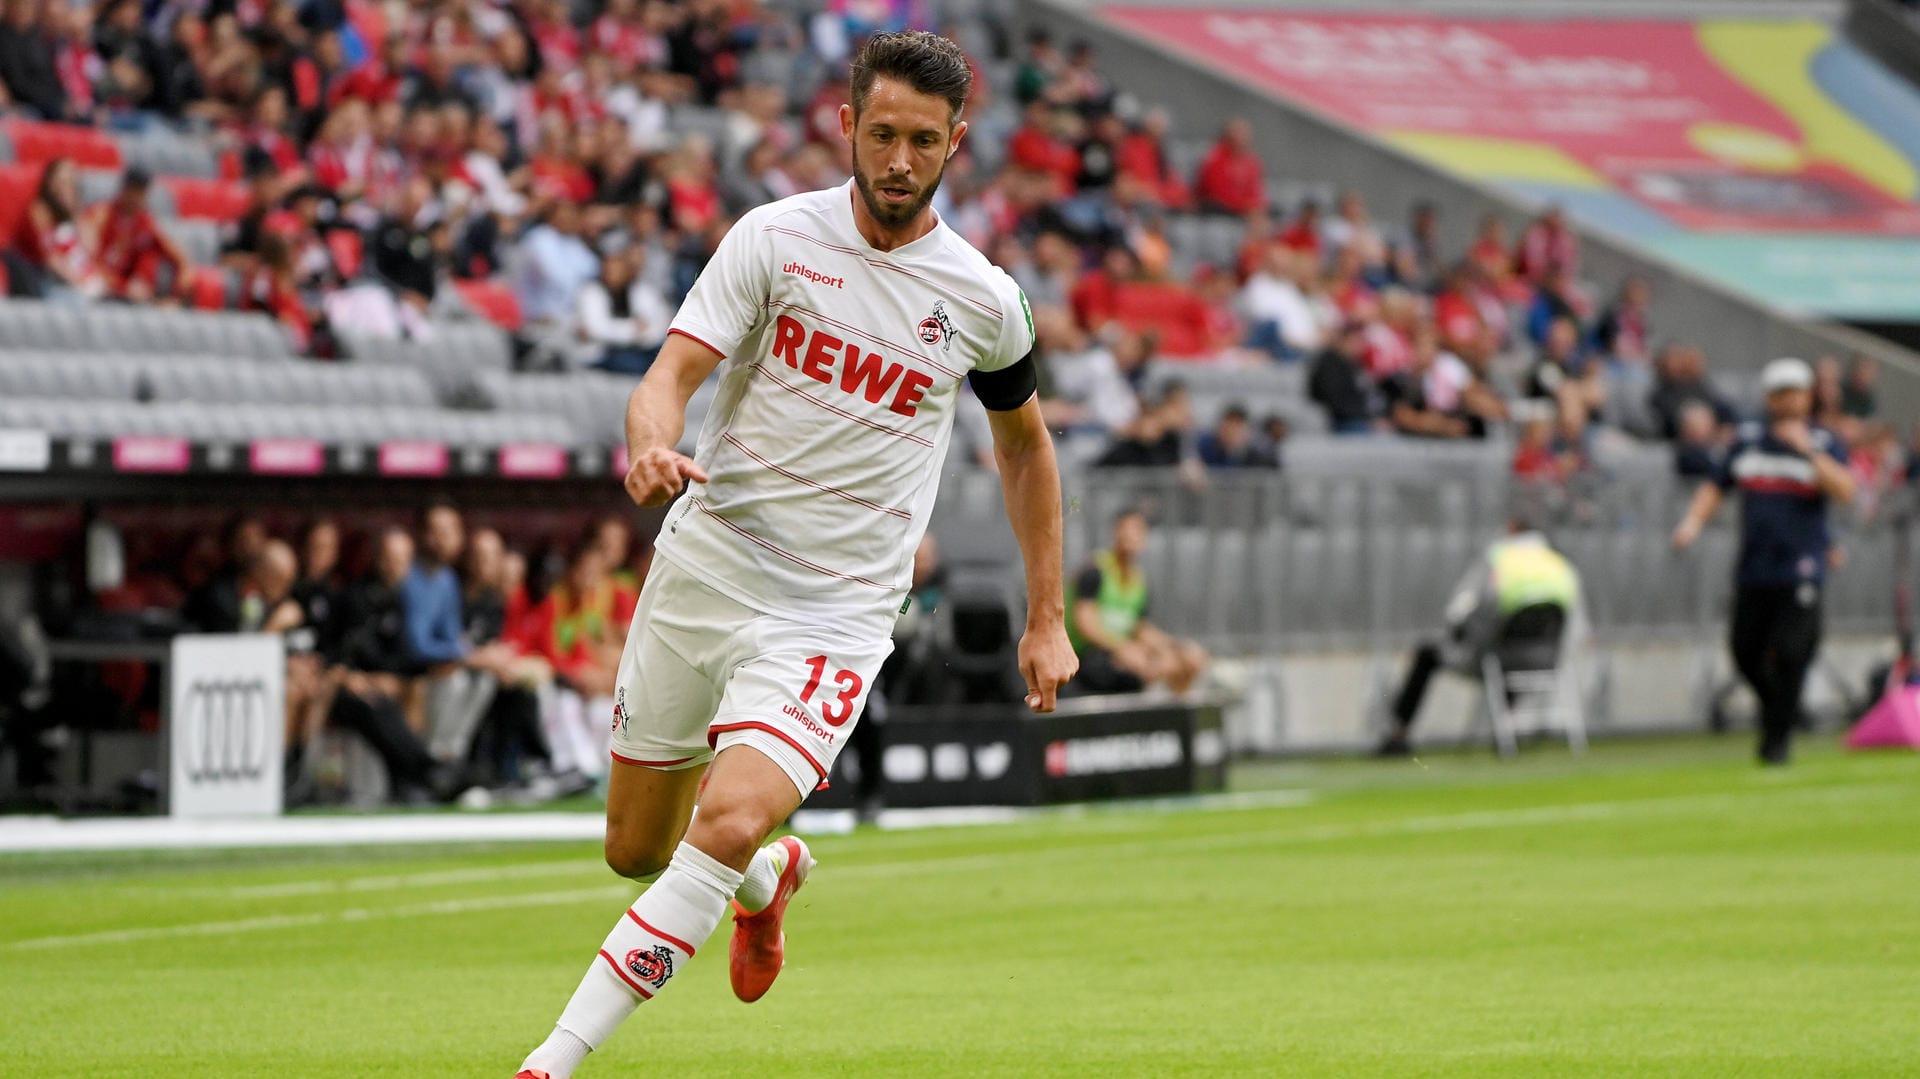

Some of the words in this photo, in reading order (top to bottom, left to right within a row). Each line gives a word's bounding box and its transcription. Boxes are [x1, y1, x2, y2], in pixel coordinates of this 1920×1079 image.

[783, 262, 844, 289] uhlsport
[772, 314, 934, 418] REWE
[799, 654, 863, 727] 13
[782, 704, 835, 745] uhlsport
